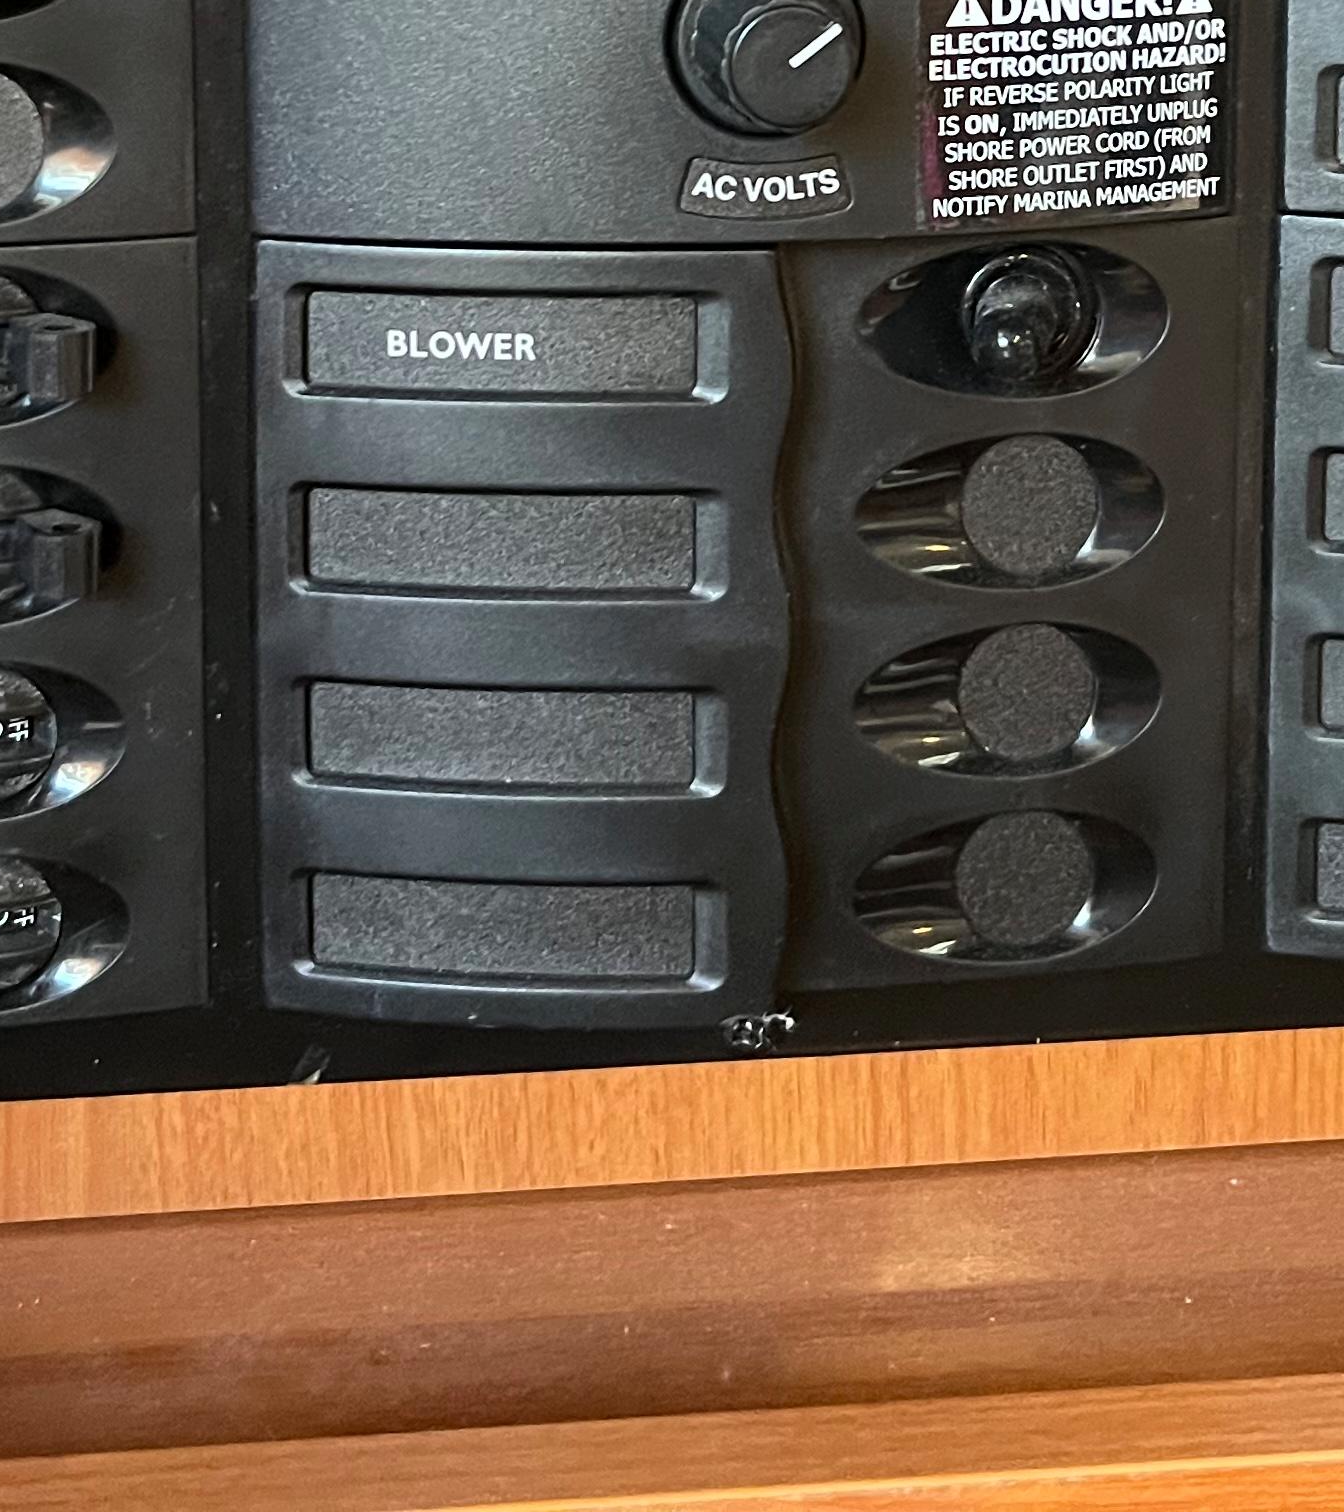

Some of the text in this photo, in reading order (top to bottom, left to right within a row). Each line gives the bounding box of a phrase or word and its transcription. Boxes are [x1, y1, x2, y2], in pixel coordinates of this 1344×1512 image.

[930, 18, 1226, 56] ELECTRIC SHOCK AND/OR
[929, 42, 1226, 82] ELECTROCUTION HAZARD!
[943, 70, 1215, 108] IF REVERSE POLARITY LIGHT
[937, 97, 1218, 137] IS ON, IMMEDIATELY UNPLUG
[944, 124, 1211, 164] SHORE POWER CORD (FROM
[690, 168, 841, 203] AC VOLTS
[948, 152, 1208, 191] SHORE OUTLET FIRST) AND
[932, 176, 1220, 218] NOTIFY MARINA MANAGEMENT
[386, 329, 536, 362] BLOWER
